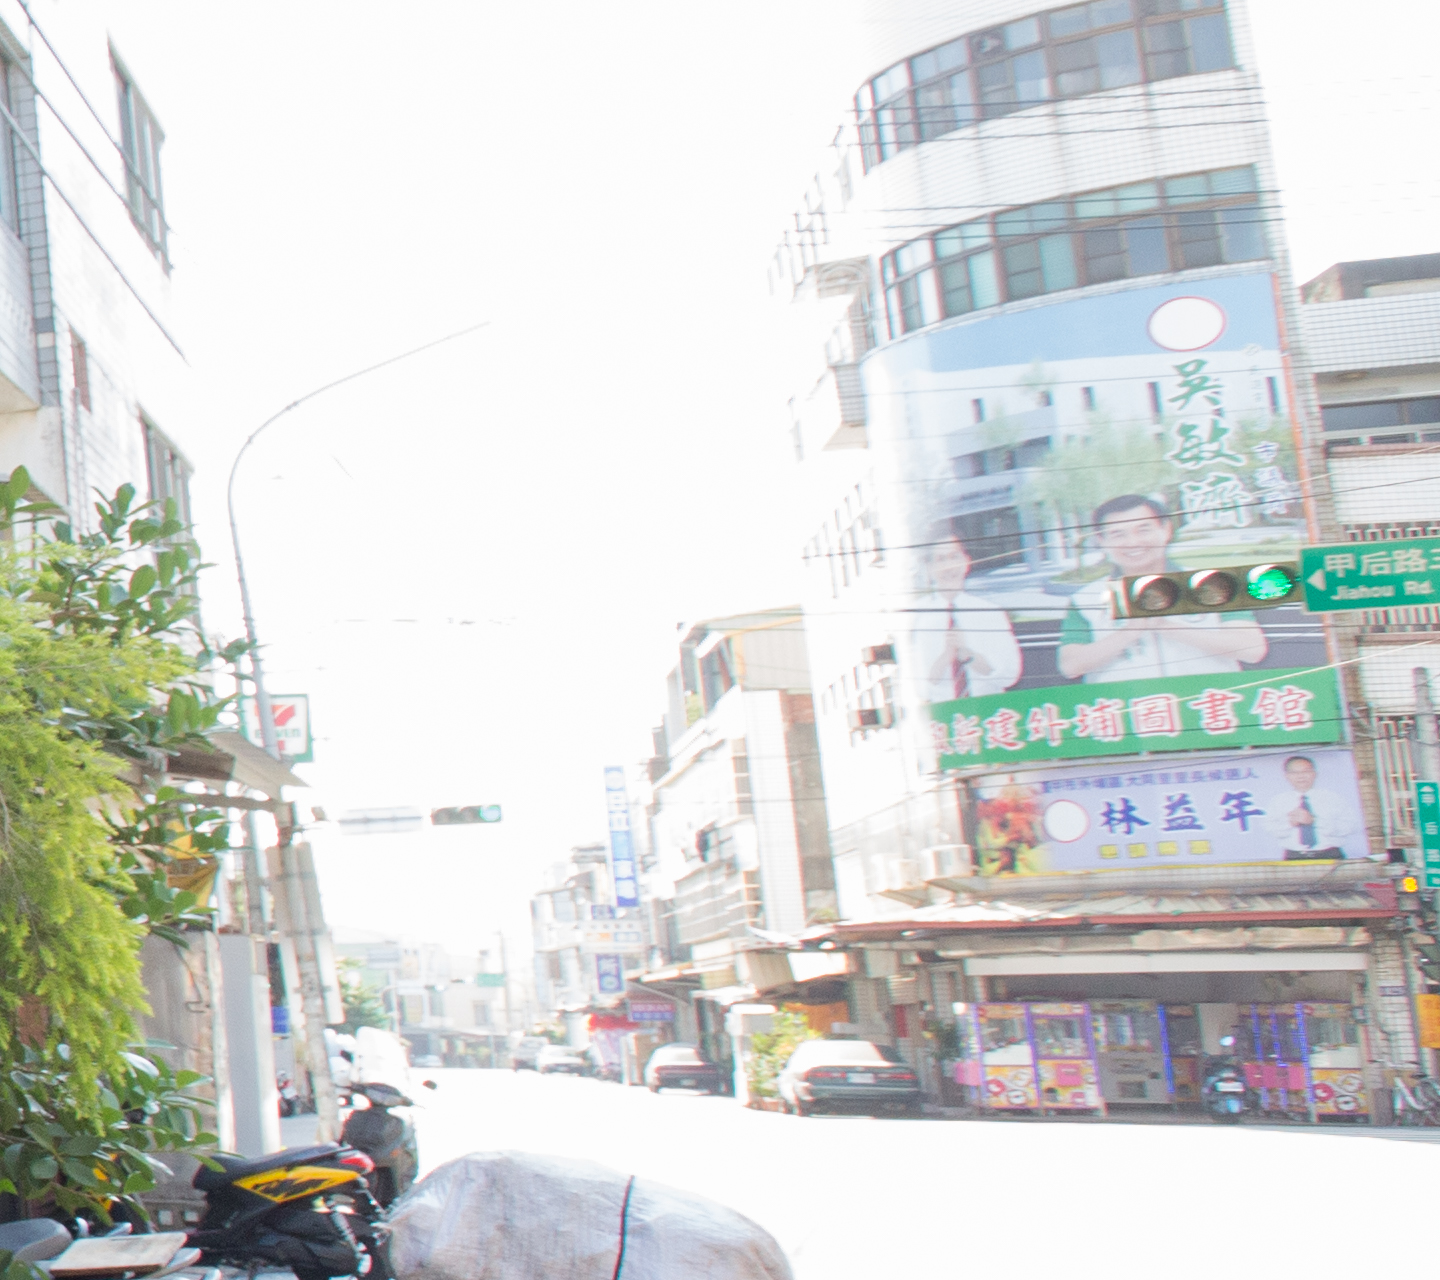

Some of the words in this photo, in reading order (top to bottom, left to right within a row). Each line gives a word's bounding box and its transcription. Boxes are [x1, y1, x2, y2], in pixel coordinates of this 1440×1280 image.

[1329, 584, 1397, 601] Jiahou
[1098, 790, 1266, 836] 林益年
